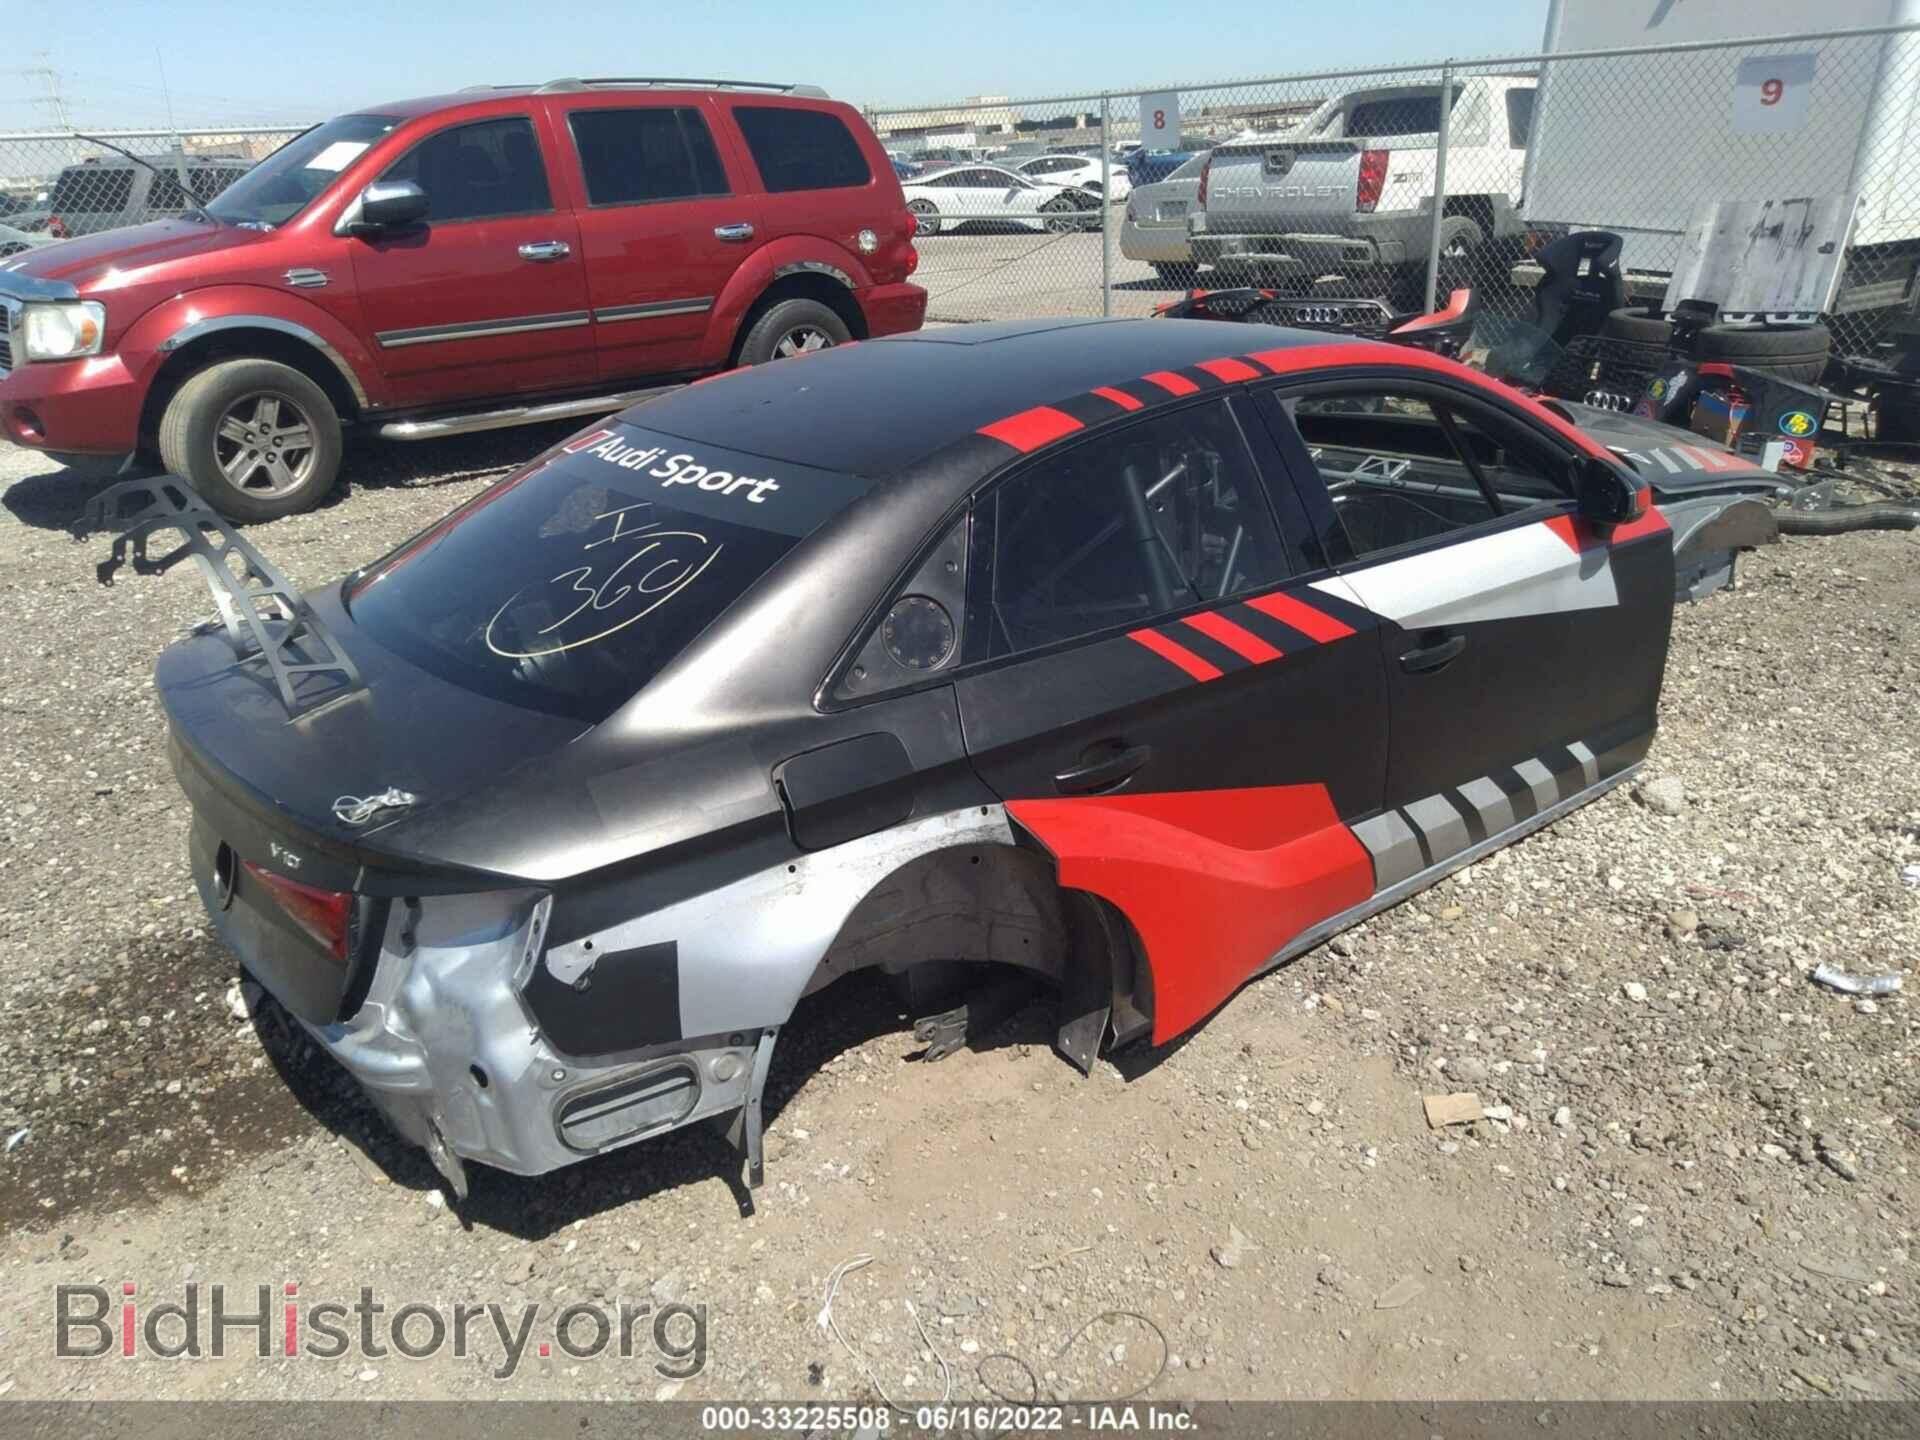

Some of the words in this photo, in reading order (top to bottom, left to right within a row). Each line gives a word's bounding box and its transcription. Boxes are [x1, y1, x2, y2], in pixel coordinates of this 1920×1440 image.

[1760, 78, 1783, 106] 9
[1154, 110, 1165, 129] 8
[1214, 185, 1349, 199] CHEVROLET
[588, 436, 666, 471] Audi
[650, 454, 780, 503] Sport
[537, 541, 694, 635] 360
[270, 842, 302, 870] V10
